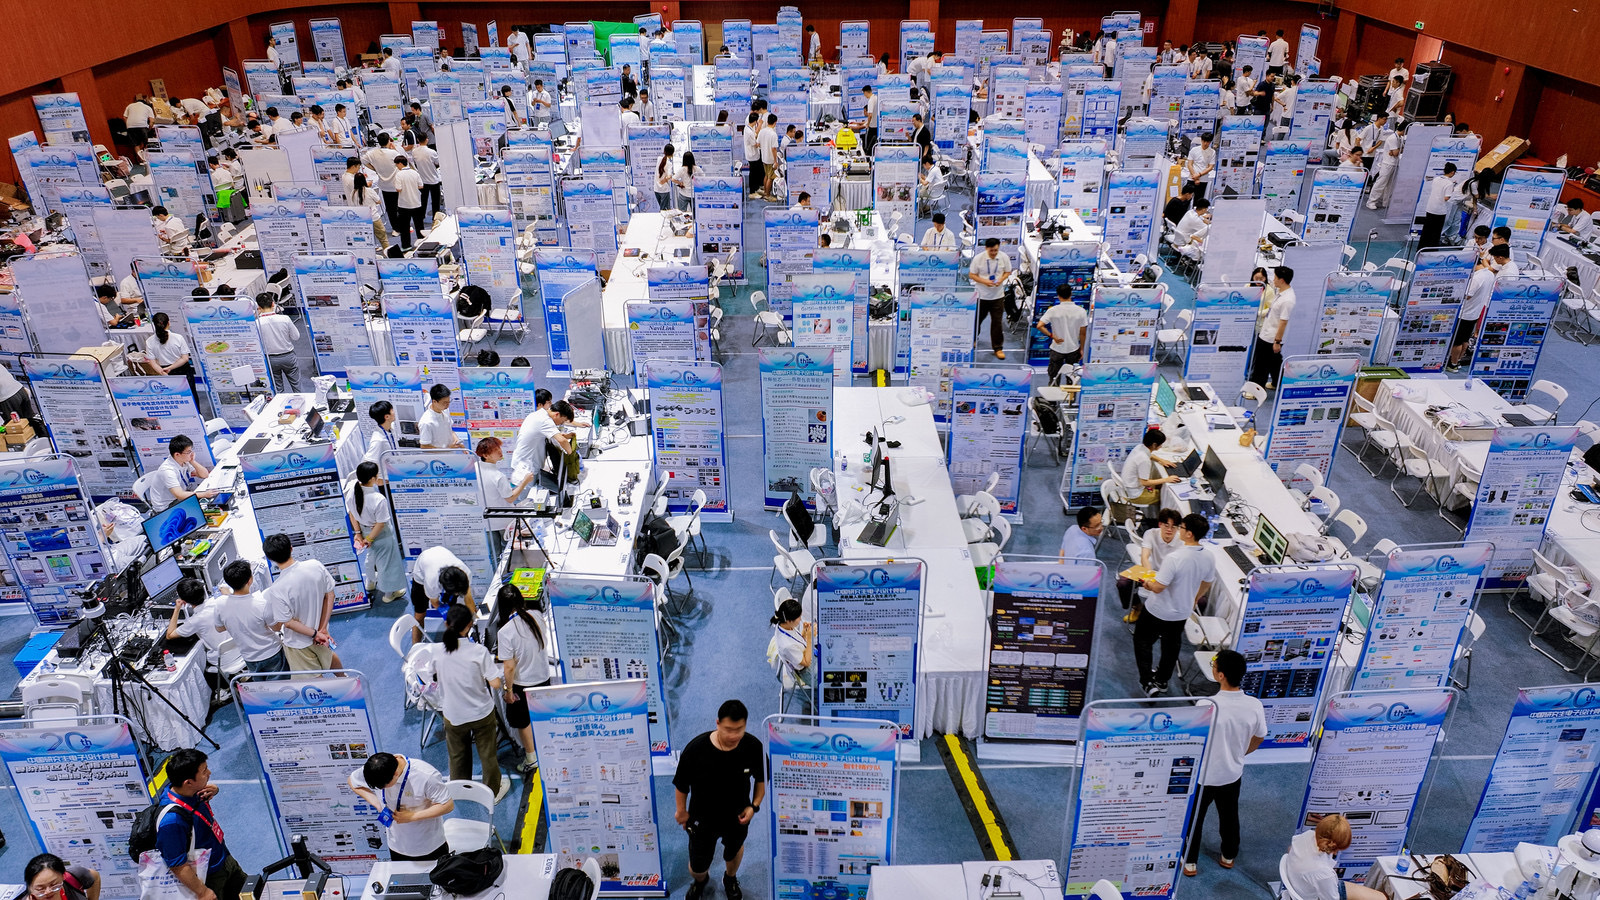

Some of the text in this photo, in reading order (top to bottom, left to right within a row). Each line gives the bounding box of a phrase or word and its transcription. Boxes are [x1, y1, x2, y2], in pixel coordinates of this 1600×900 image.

[1520, 433, 1550, 449] 20th
[271, 452, 304, 470] 20th
[413, 460, 447, 476] 20th
[4, 468, 43, 485] 20th
[1418, 555, 1454, 572] 20th
[852, 568, 889, 586] 20th
[1029, 572, 1064, 591] 20th
[583, 585, 621, 604] 20th
[1282, 578, 1319, 596] 20th
[279, 685, 325, 706] 20th
[567, 691, 611, 713] 20th
[1552, 687, 1596, 708] 20th
[266, 706, 350, 717] 中国研究生电子设计竞赛
[550, 713, 632, 724] 中国研究生电子设计竞赛
[1365, 702, 1409, 722] 20th
[1129, 712, 1172, 732] 20th
[1343, 723, 1426, 733] 中国研究生电子设计竞赛
[40, 732, 92, 752] 20th
[809, 732, 854, 753] 20th
[782, 760, 828, 768] 南京师范大学
[789, 752, 878, 763] 中国研究生电子设计竞赛
[544, 858, 554, 875] XB03
